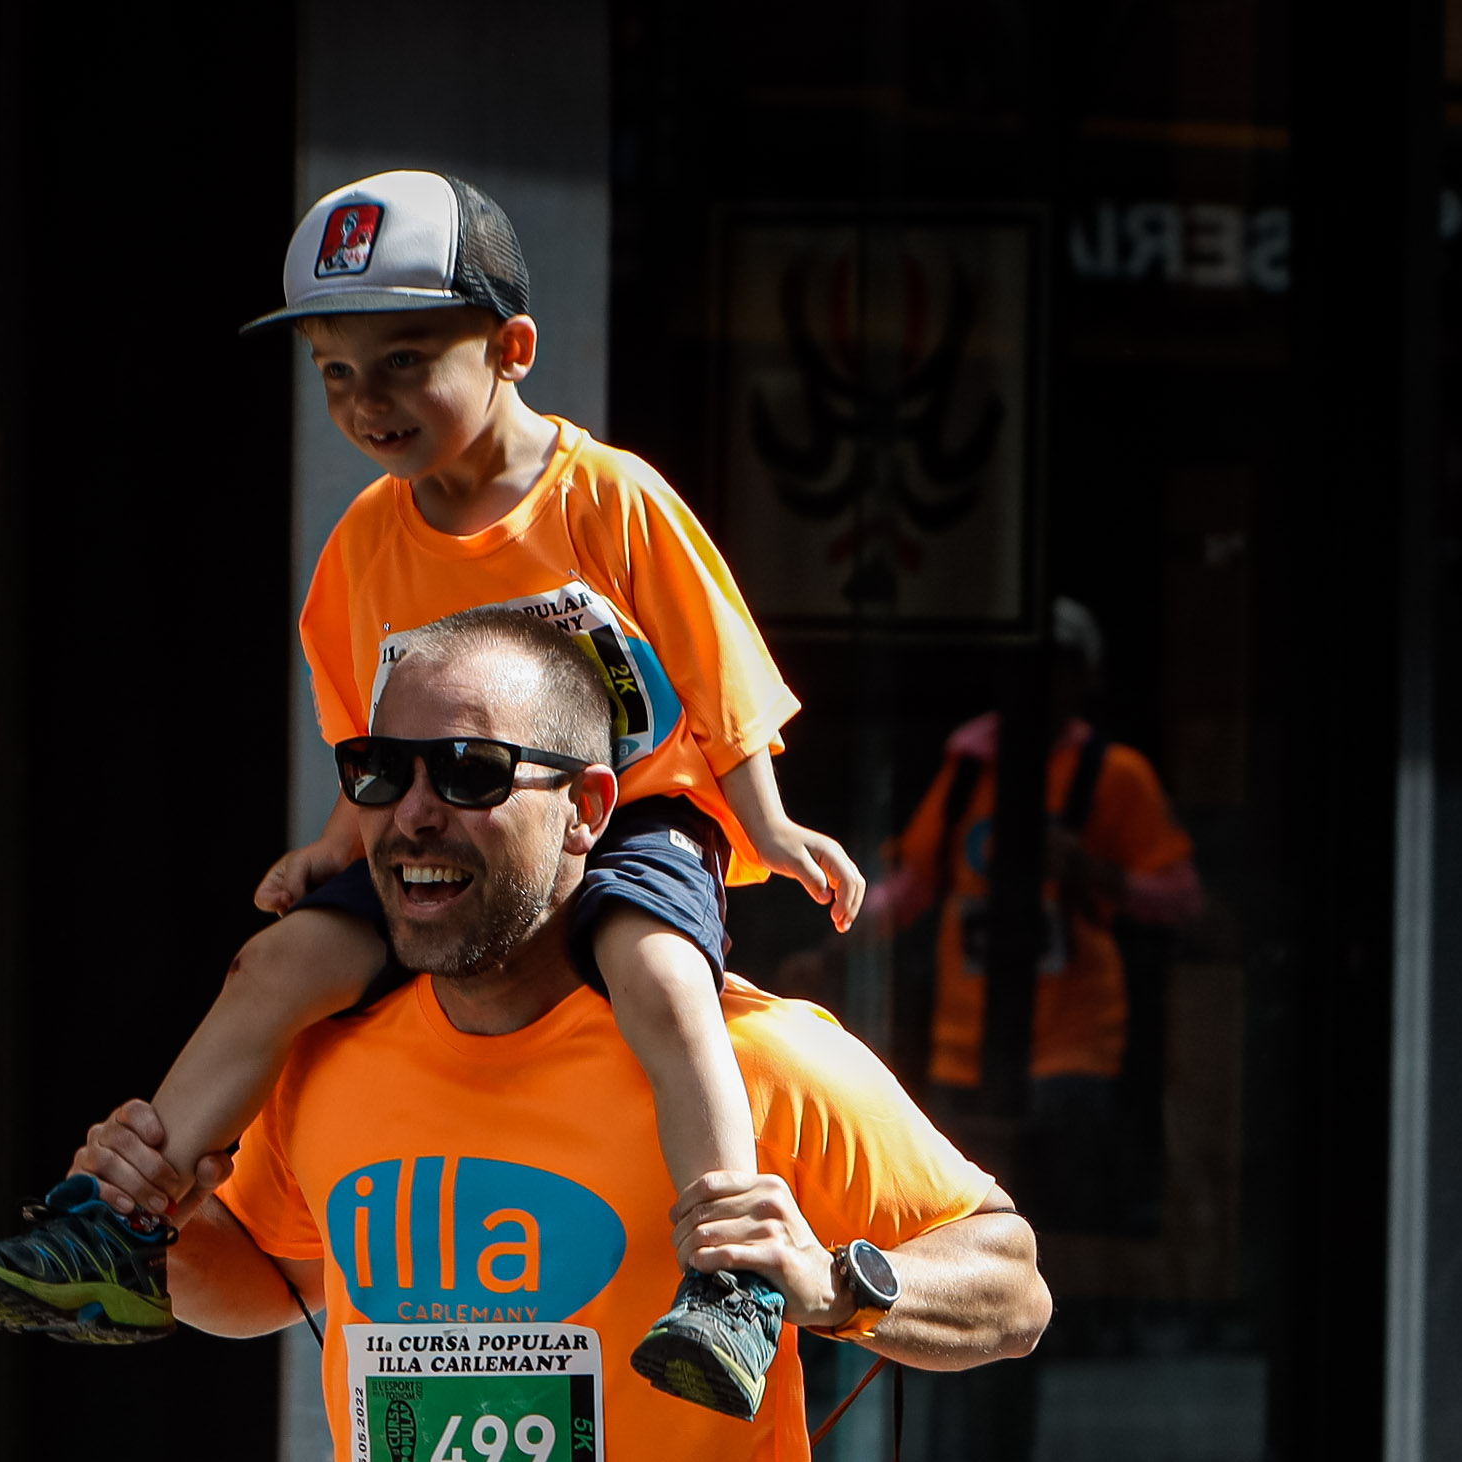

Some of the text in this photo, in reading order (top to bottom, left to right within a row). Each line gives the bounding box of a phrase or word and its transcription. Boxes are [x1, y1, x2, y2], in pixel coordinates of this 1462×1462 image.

[523, 592, 593, 619] PULAR
[609, 664, 637, 695] 2K
[354, 1155, 539, 1294] illa
[397, 1302, 538, 1323] CARLEMANY
[398, 1335, 470, 1352] CURSA
[478, 1334, 589, 1351] POPULAR
[378, 1355, 573, 1373] ILLA CARLEMANY
[574, 1417, 594, 1453] 5K
